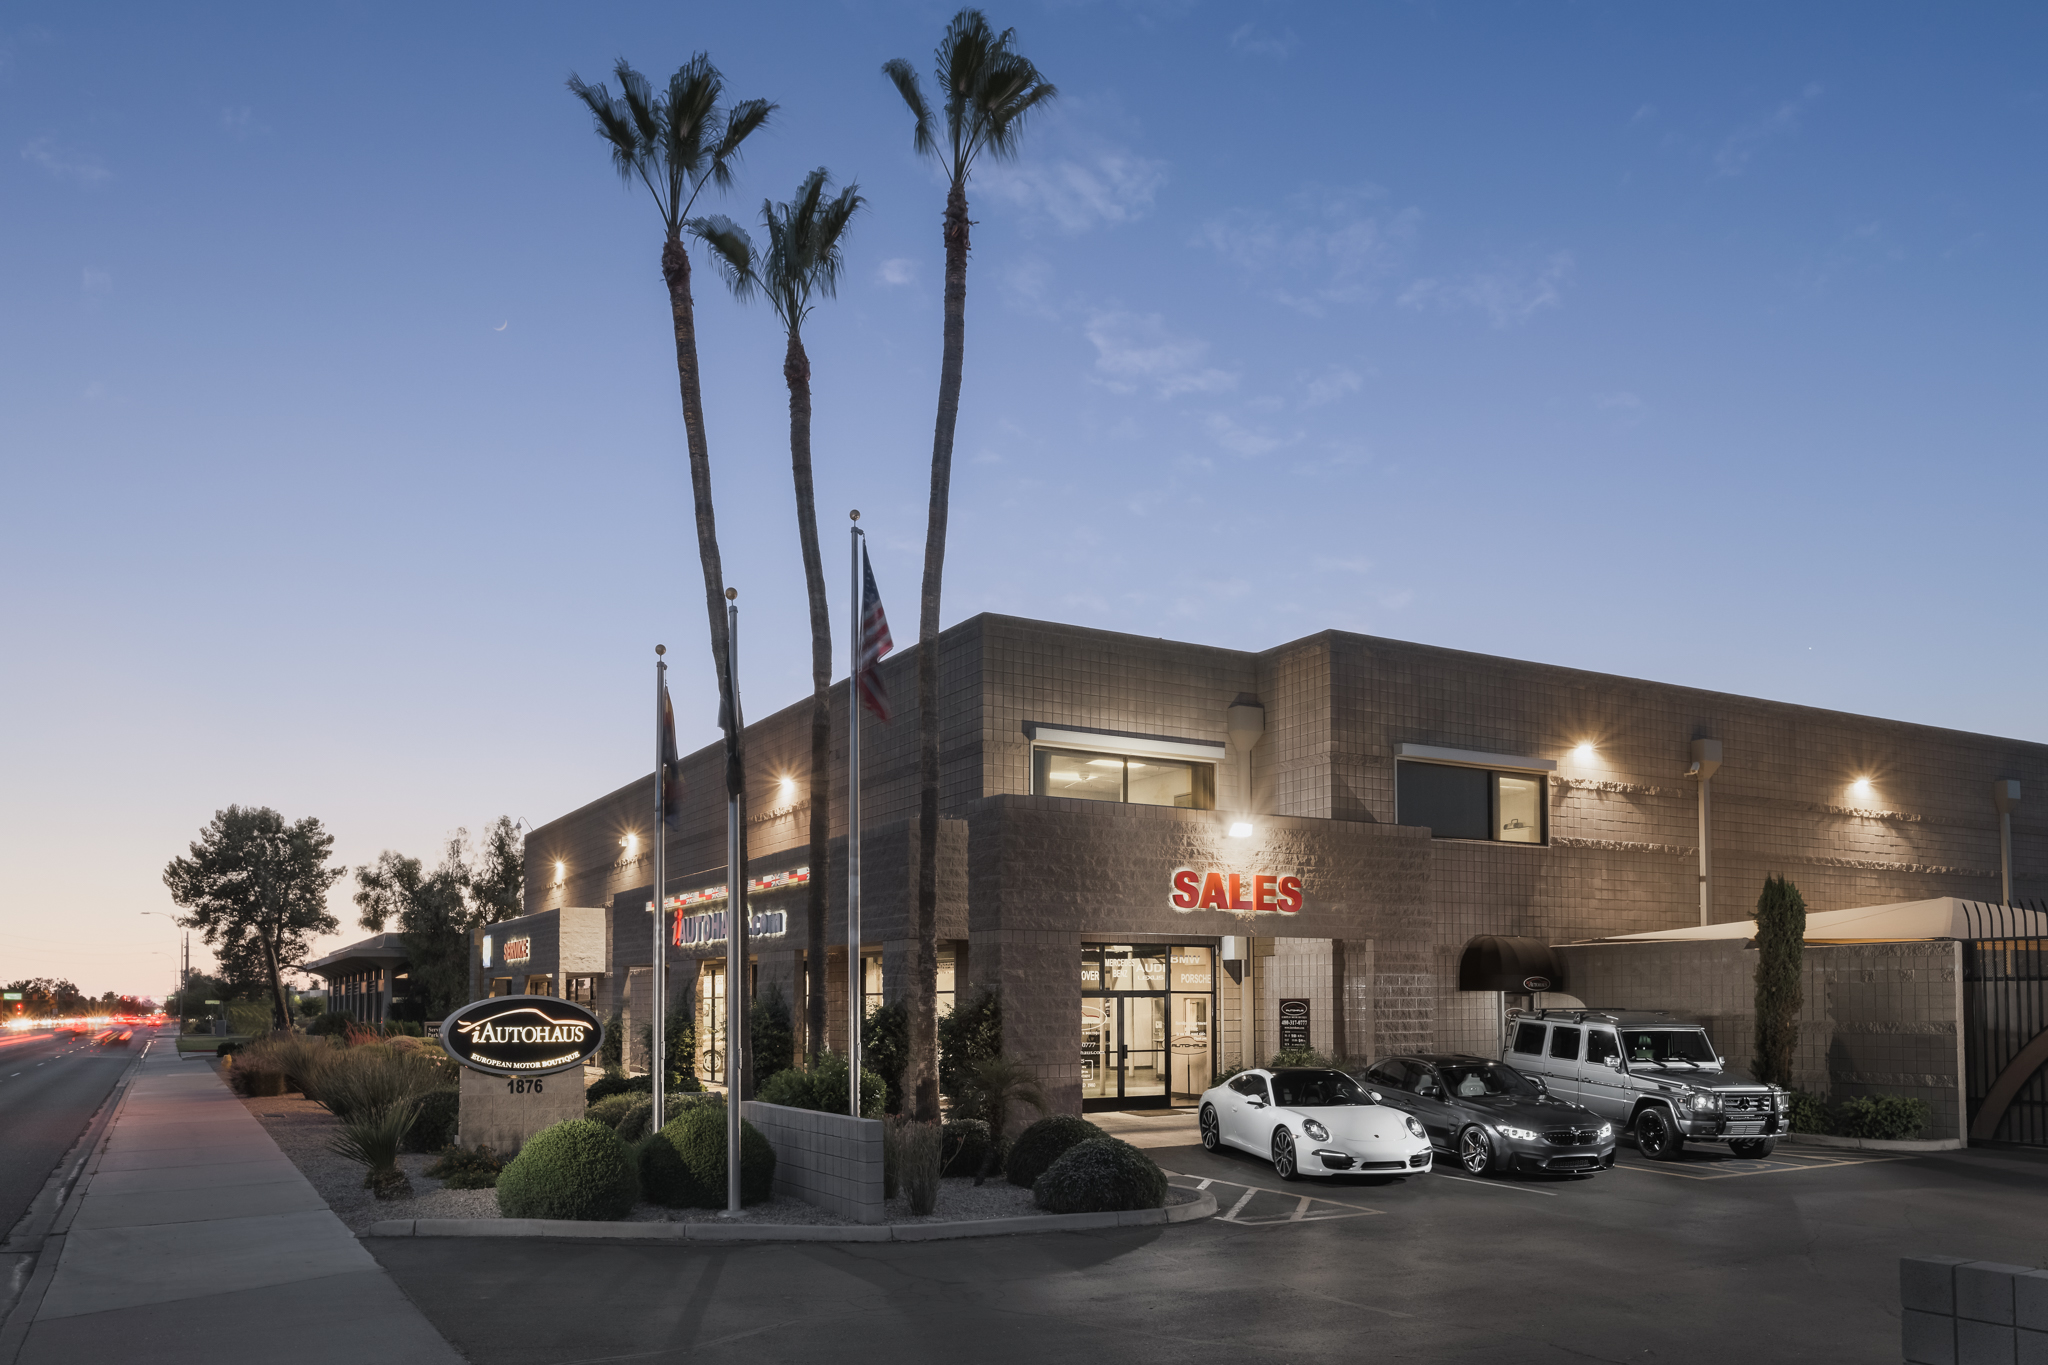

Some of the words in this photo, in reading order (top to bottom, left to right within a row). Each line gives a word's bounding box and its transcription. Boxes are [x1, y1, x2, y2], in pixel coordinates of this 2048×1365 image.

[1172, 870, 1303, 912] SALES
[672, 908, 783, 946] iAUTOHA.com
[503, 939, 529, 961] SERVICE
[1105, 958, 1135, 967] MERCEDES
[1170, 954, 1200, 964] BMW
[1112, 969, 1128, 978] BENZ
[1136, 963, 1166, 973] AUDI
[1180, 973, 1212, 984] PORSCHE
[470, 1052, 513, 1069] EUROPEAN
[512, 1061, 542, 1070] MOTOR
[541, 1050, 581, 1068] BOUTIQUE
[507, 1079, 543, 1095] 1876
